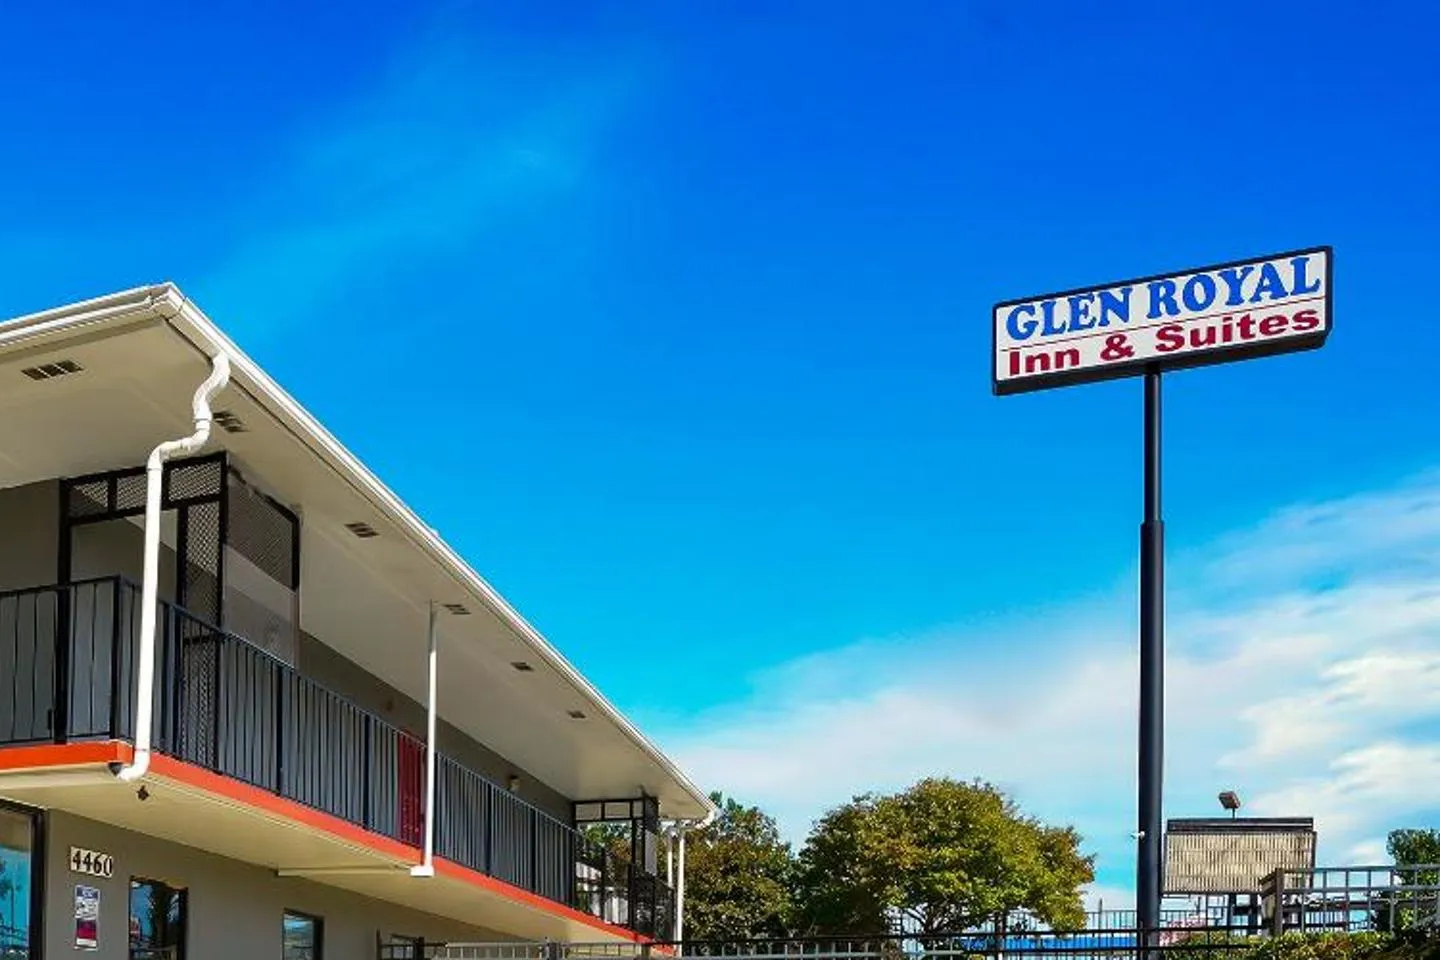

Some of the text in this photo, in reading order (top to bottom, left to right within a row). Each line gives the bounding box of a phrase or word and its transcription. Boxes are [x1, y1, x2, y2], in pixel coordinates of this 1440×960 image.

[1006, 257, 1321, 340] GLEN ROYAL
[1010, 309, 1320, 375] Inn & Suites
[72, 850, 113, 876] 4460
